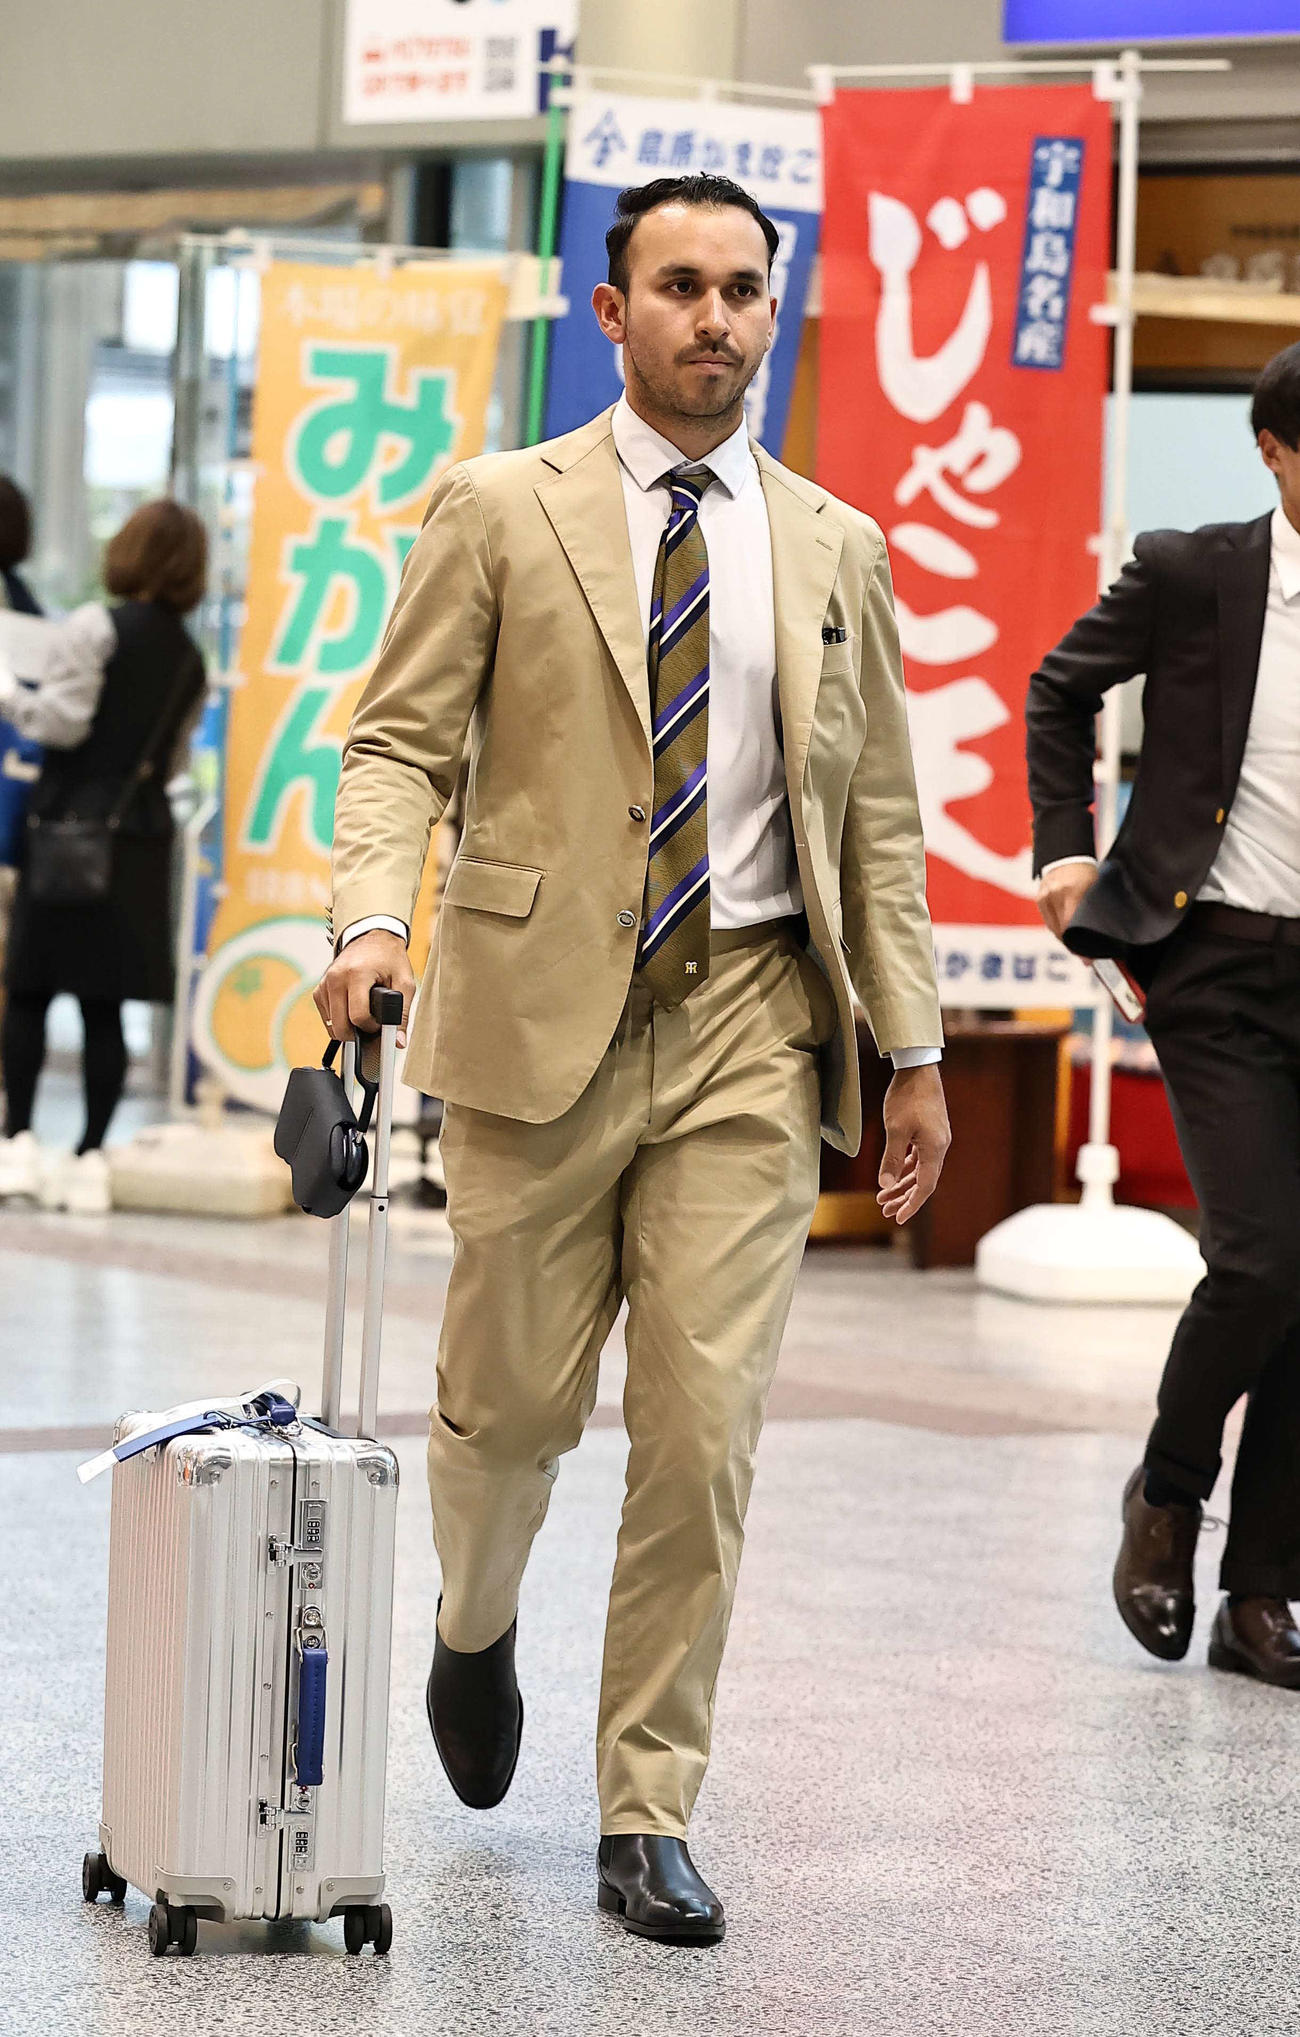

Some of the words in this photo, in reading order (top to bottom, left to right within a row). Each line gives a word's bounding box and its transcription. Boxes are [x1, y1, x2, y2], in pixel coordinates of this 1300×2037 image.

[1016, 140, 1081, 367] 宇和島名産
[239, 341, 462, 853] みかん
